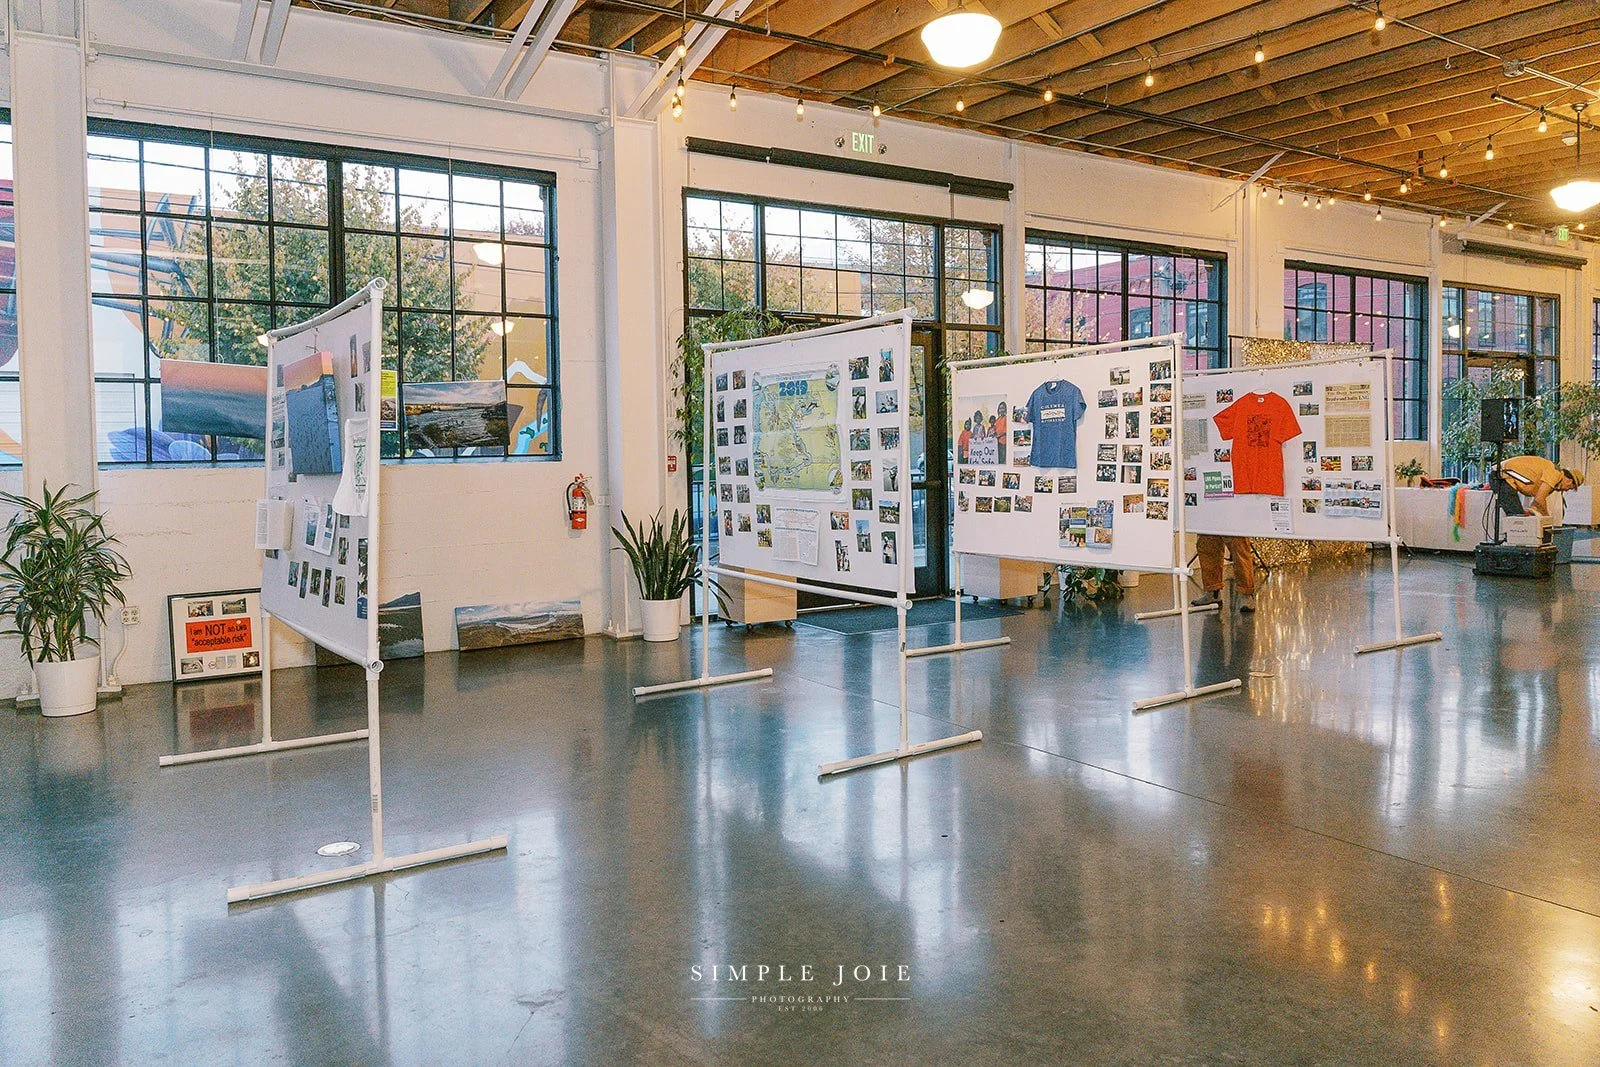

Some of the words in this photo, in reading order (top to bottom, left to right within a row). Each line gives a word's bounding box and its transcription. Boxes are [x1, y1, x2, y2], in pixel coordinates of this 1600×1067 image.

[852, 132, 874, 154] EXIT
[779, 380, 808, 396] 2019
[1223, 480, 1232, 488] NO
[205, 624, 226, 636] NOT
